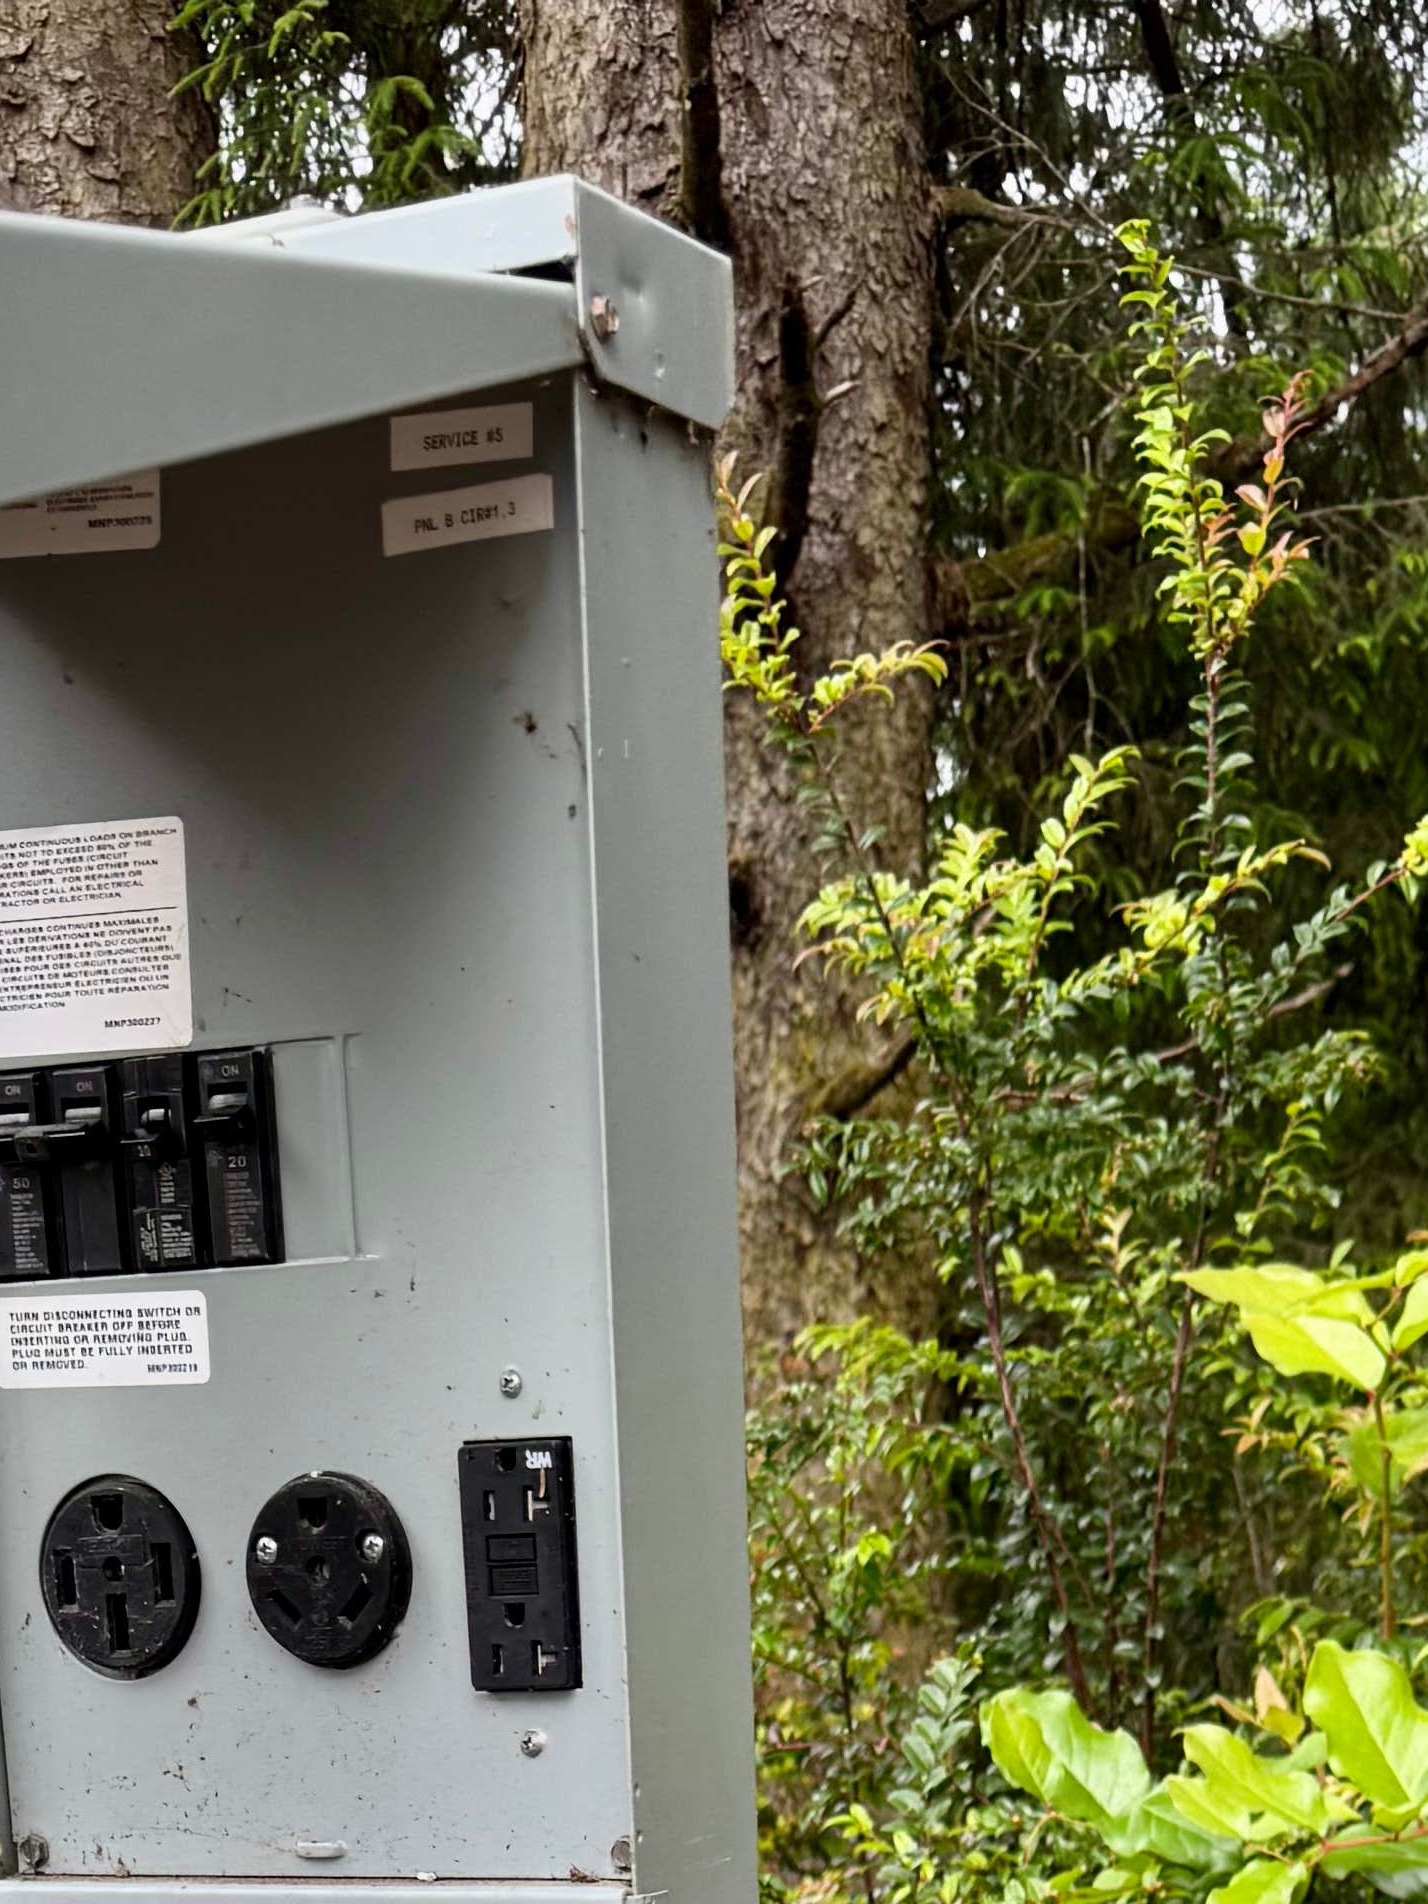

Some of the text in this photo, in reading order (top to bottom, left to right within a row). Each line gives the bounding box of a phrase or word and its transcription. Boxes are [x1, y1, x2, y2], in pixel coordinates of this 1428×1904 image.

[423, 430, 479, 451] SERVICE
[414, 518, 439, 534] PNL
[19, 836, 80, 848] CONTINUOUS
[83, 833, 116, 843] LOADS
[118, 832, 132, 840] ON
[135, 828, 176, 839] BRANCH
[18, 850, 38, 858] NOT
[56, 845, 94, 855] EXCEED
[118, 842, 130, 850] OF
[133, 840, 152, 849] THE
[30, 865, 82, 877] EMPLOYED
[84, 864, 94, 872] IN
[96, 861, 130, 871] OTHER
[133, 859, 158, 868] THAN
[32, 859, 50, 867] THE
[62, 875, 82, 884] FOR
[84, 872, 125, 882] REPAIRS
[128, 870, 142, 878] OR
[42, 886, 66, 895] CALL
[69, 885, 82, 893] AN
[85, 880, 144, 891] ELECTRICAL
[42, 897, 56, 905] OR
[46, 921, 100, 932] CONTINUES
[7, 937, 24, 945] LES
[153, 925, 172, 933] PAS
[120, 935, 166, 945] COURANT
[24, 954, 42, 963] DES
[24, 963, 49, 972] POUR
[74, 958, 118, 968] CIRCUITS
[120, 955, 158, 965] AUTRES
[44, 990, 70, 999] POUR
[74, 988, 104, 997] TOUTE
[221, 1064, 240, 1077] ON
[4, 1084, 21, 1096] ON
[76, 1080, 93, 1092] ON
[228, 1156, 247, 1168] 20
[12, 1178, 30, 1190] 50
[9, 1306, 200, 1322] TURN DISCONNECTING SWITCH OR
[10, 1319, 180, 1334] CIRCUIT BREAKER OFF BEFORE
[73, 1334, 90, 1344] OR
[93, 1332, 152, 1344] REMOVING
[12, 1343, 192, 1359] PLUG MUST BE FULLY INSERTED
[12, 1360, 27, 1371] OR
